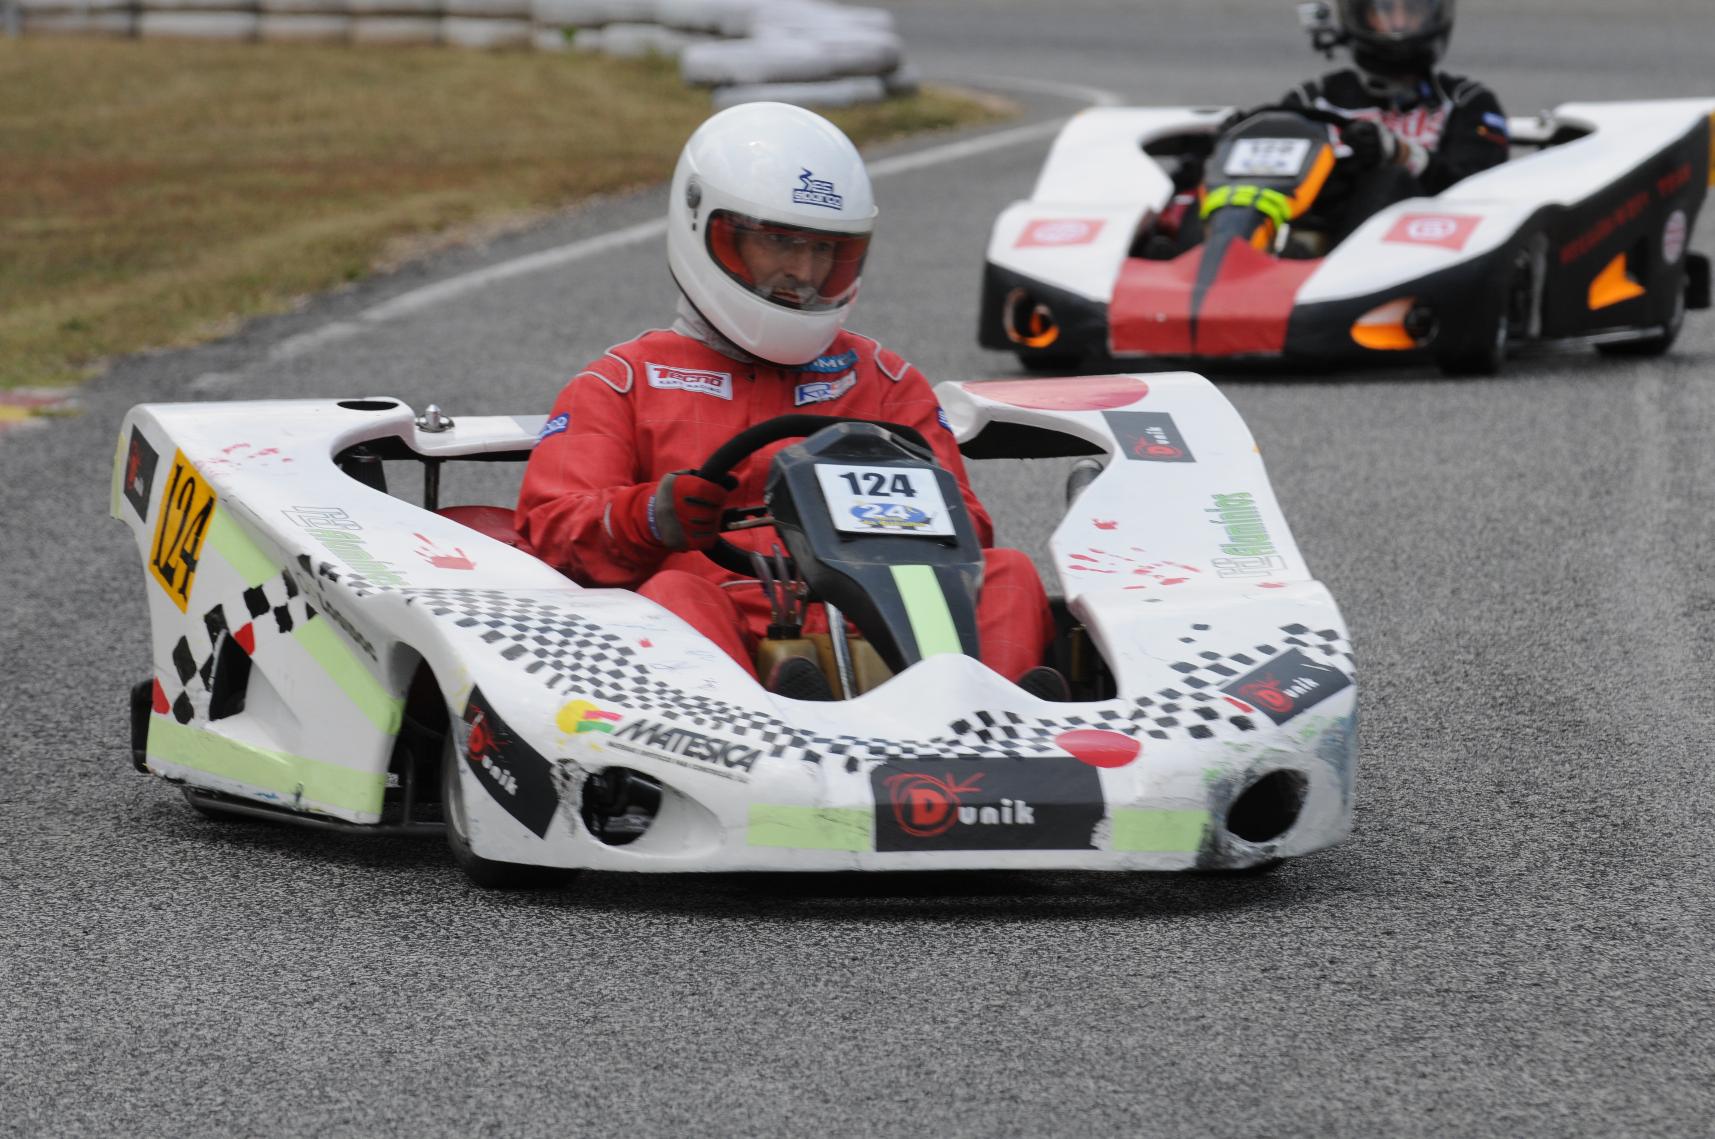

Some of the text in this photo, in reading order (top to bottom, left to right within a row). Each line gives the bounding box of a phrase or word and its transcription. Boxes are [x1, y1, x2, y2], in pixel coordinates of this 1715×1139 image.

[838, 472, 918, 498] 124
[153, 464, 215, 603] 124
[612, 718, 763, 774] MATESKA
[909, 788, 1035, 826] Dunik
